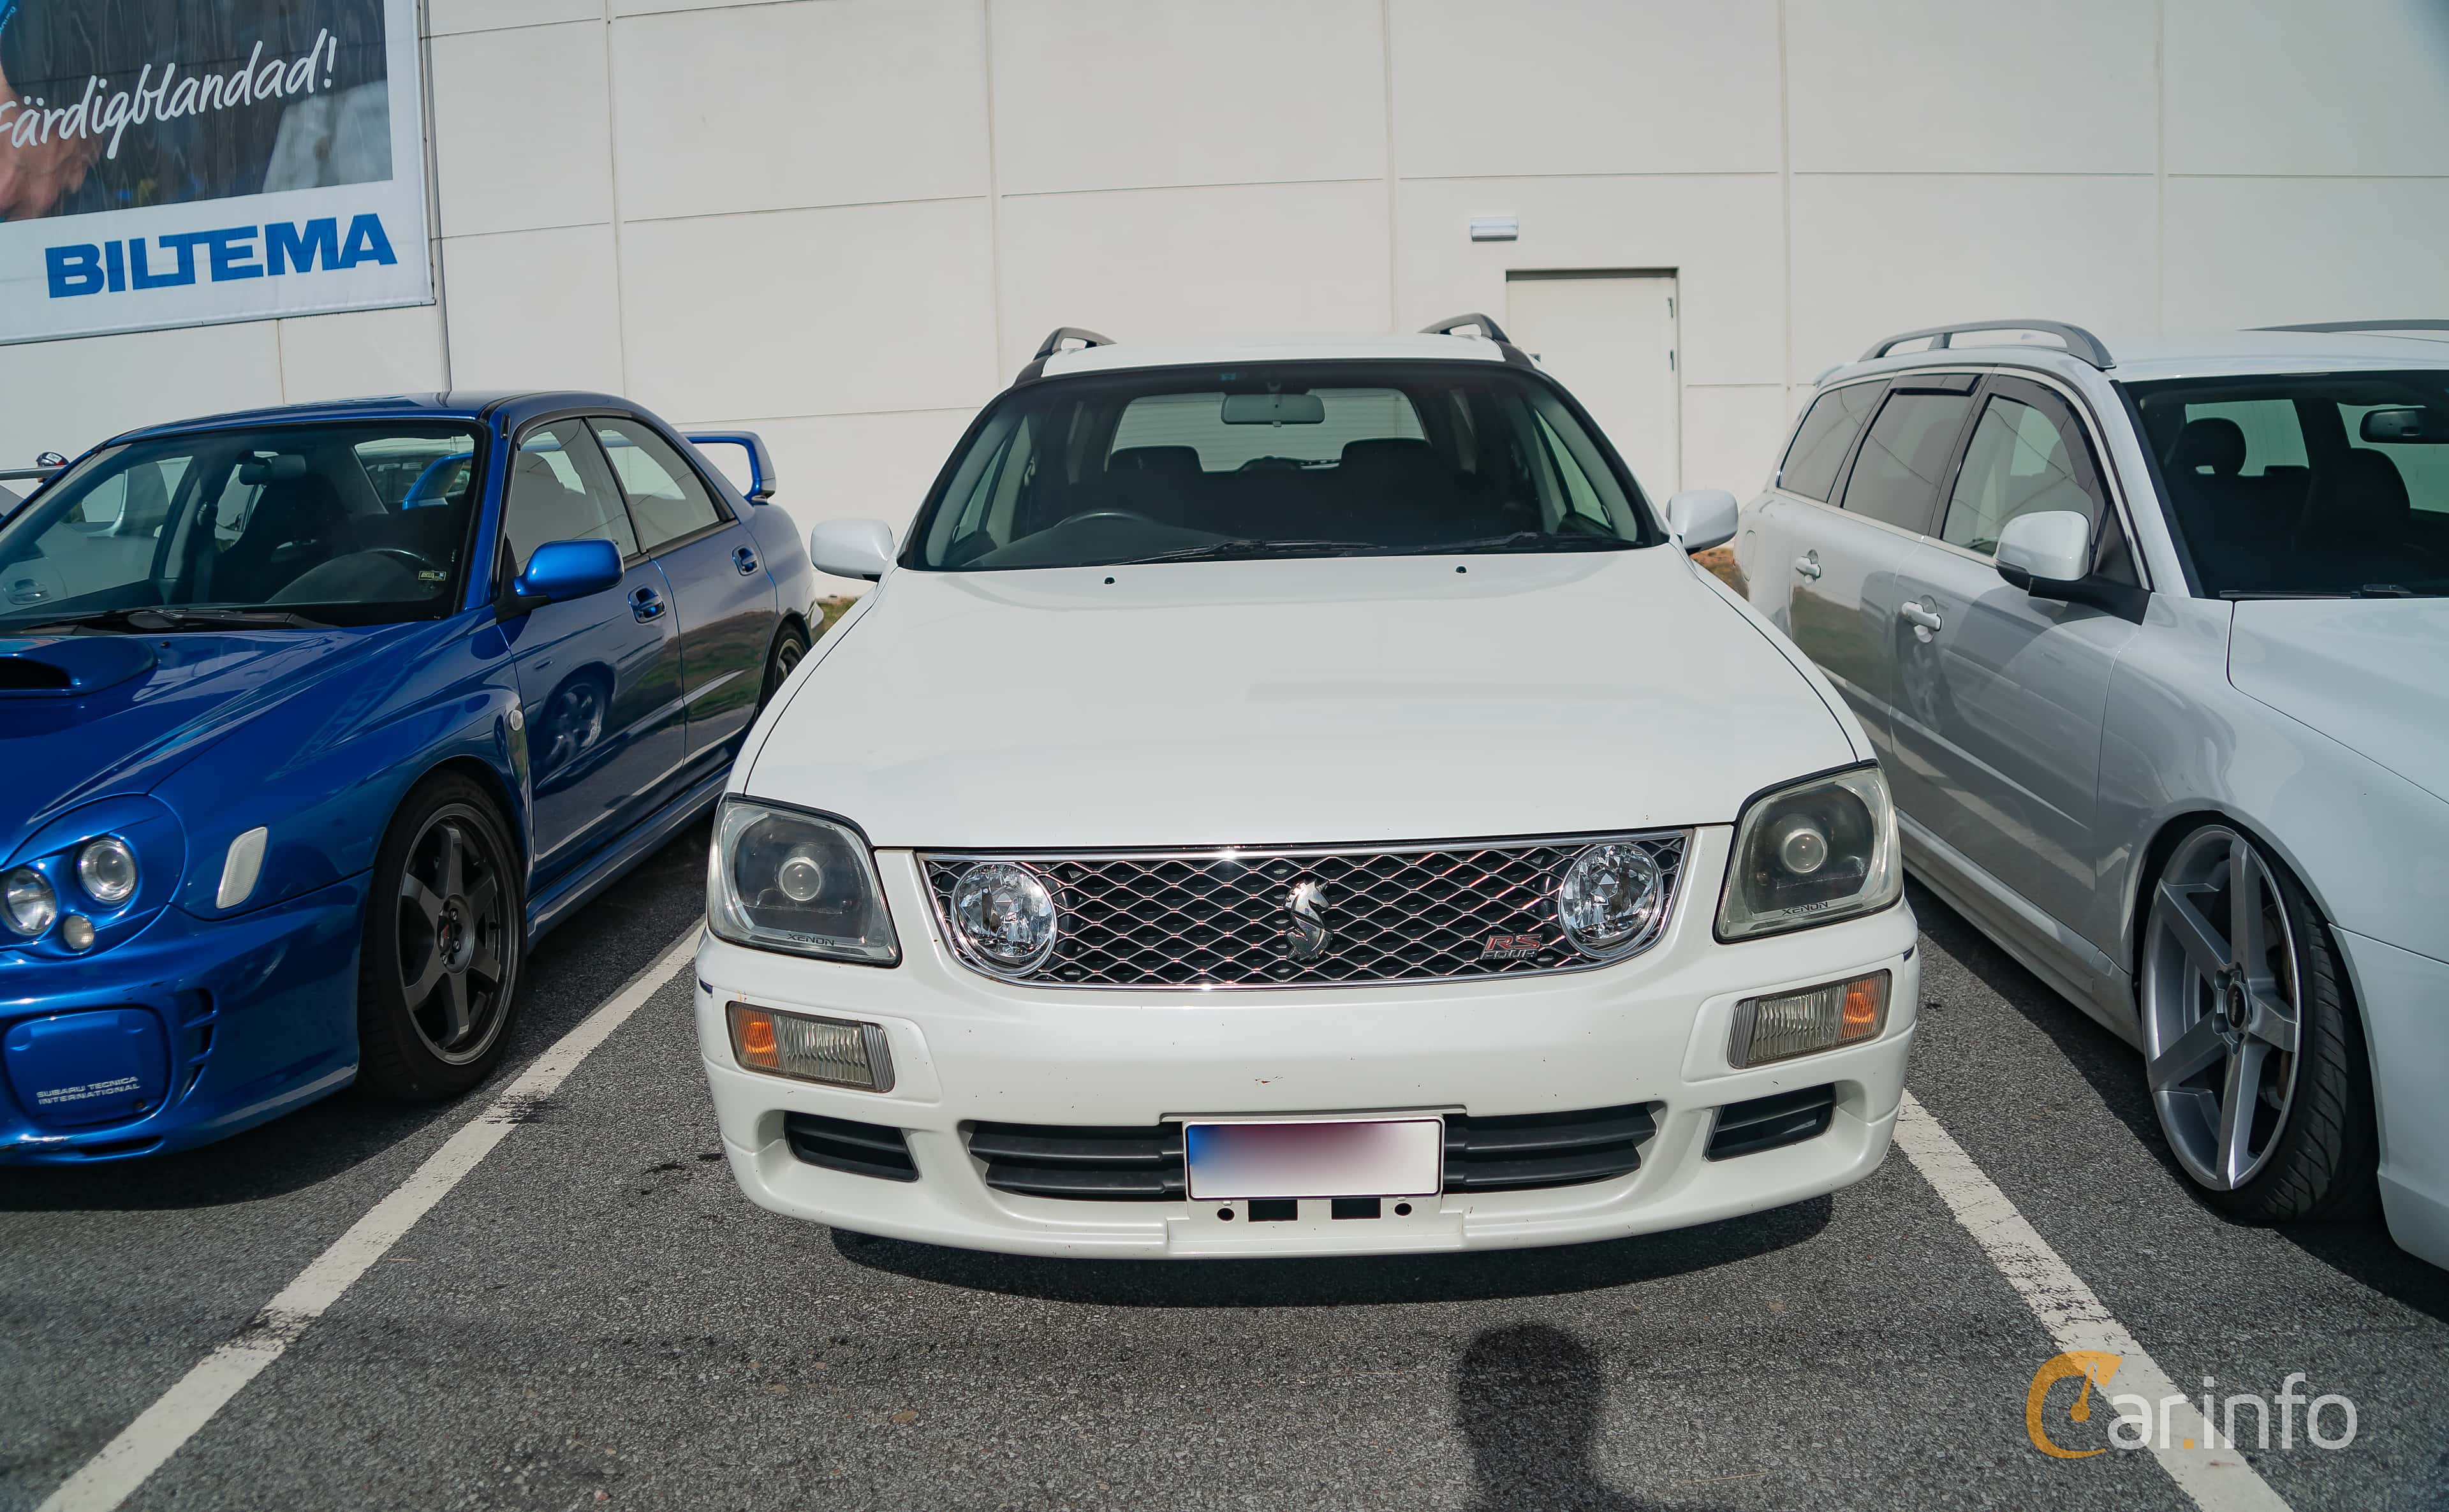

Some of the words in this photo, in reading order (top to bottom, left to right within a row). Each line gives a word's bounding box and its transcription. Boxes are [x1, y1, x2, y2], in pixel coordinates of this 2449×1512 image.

[45, 212, 398, 298] BILTEMA
[1781, 901, 1828, 916] XENON
[786, 933, 835, 946] XENON
[1485, 934, 1541, 950] RS
[1480, 949, 1538, 960] FOUR
[36, 1085, 86, 1097] SUBARU
[87, 1076, 138, 1090] TECNICA
[38, 1083, 141, 1105] INTERNATIONAL
